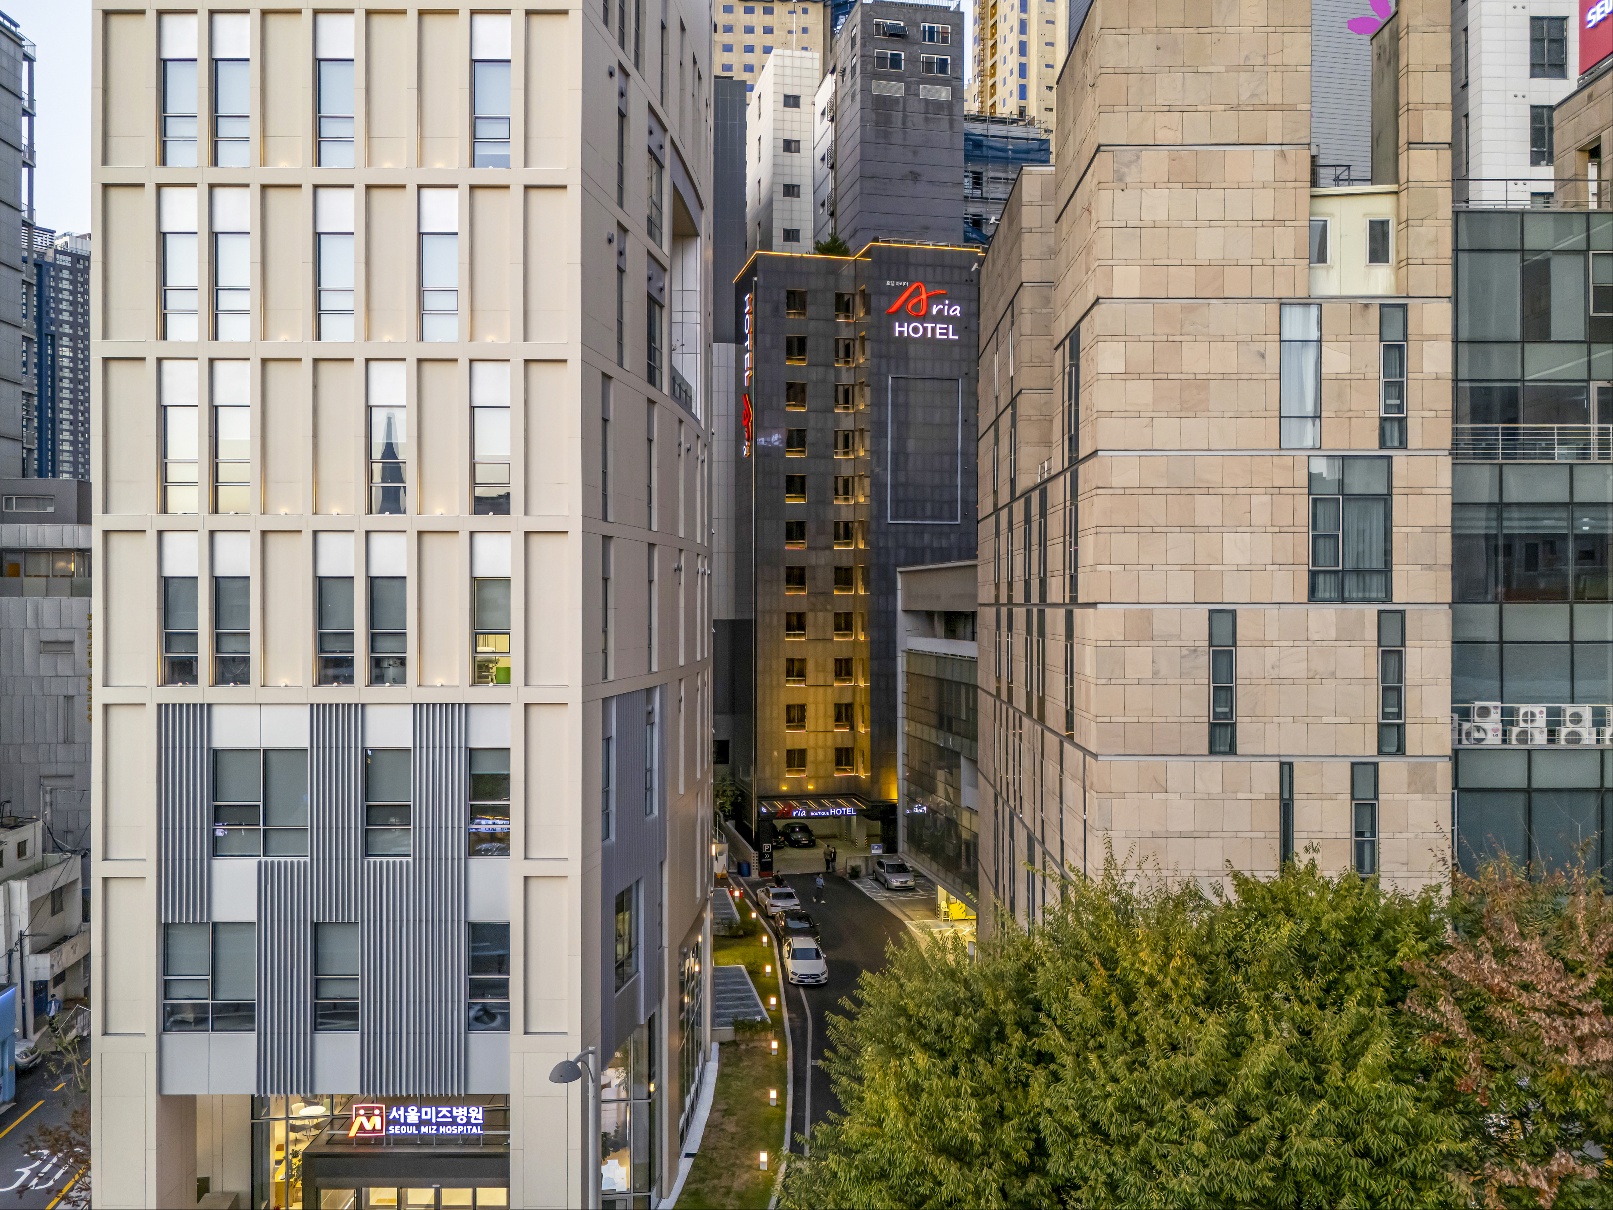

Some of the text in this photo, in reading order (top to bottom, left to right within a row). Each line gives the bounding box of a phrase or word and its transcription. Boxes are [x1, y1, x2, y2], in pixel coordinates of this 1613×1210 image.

[885, 281, 961, 317] Aria
[894, 321, 959, 340] HOTEL
[829, 807, 857, 816] HOTEL
[388, 1106, 484, 1124] 서울미즈병원
[388, 1125, 484, 1134] SEOUL MIZ HOSPITAL
